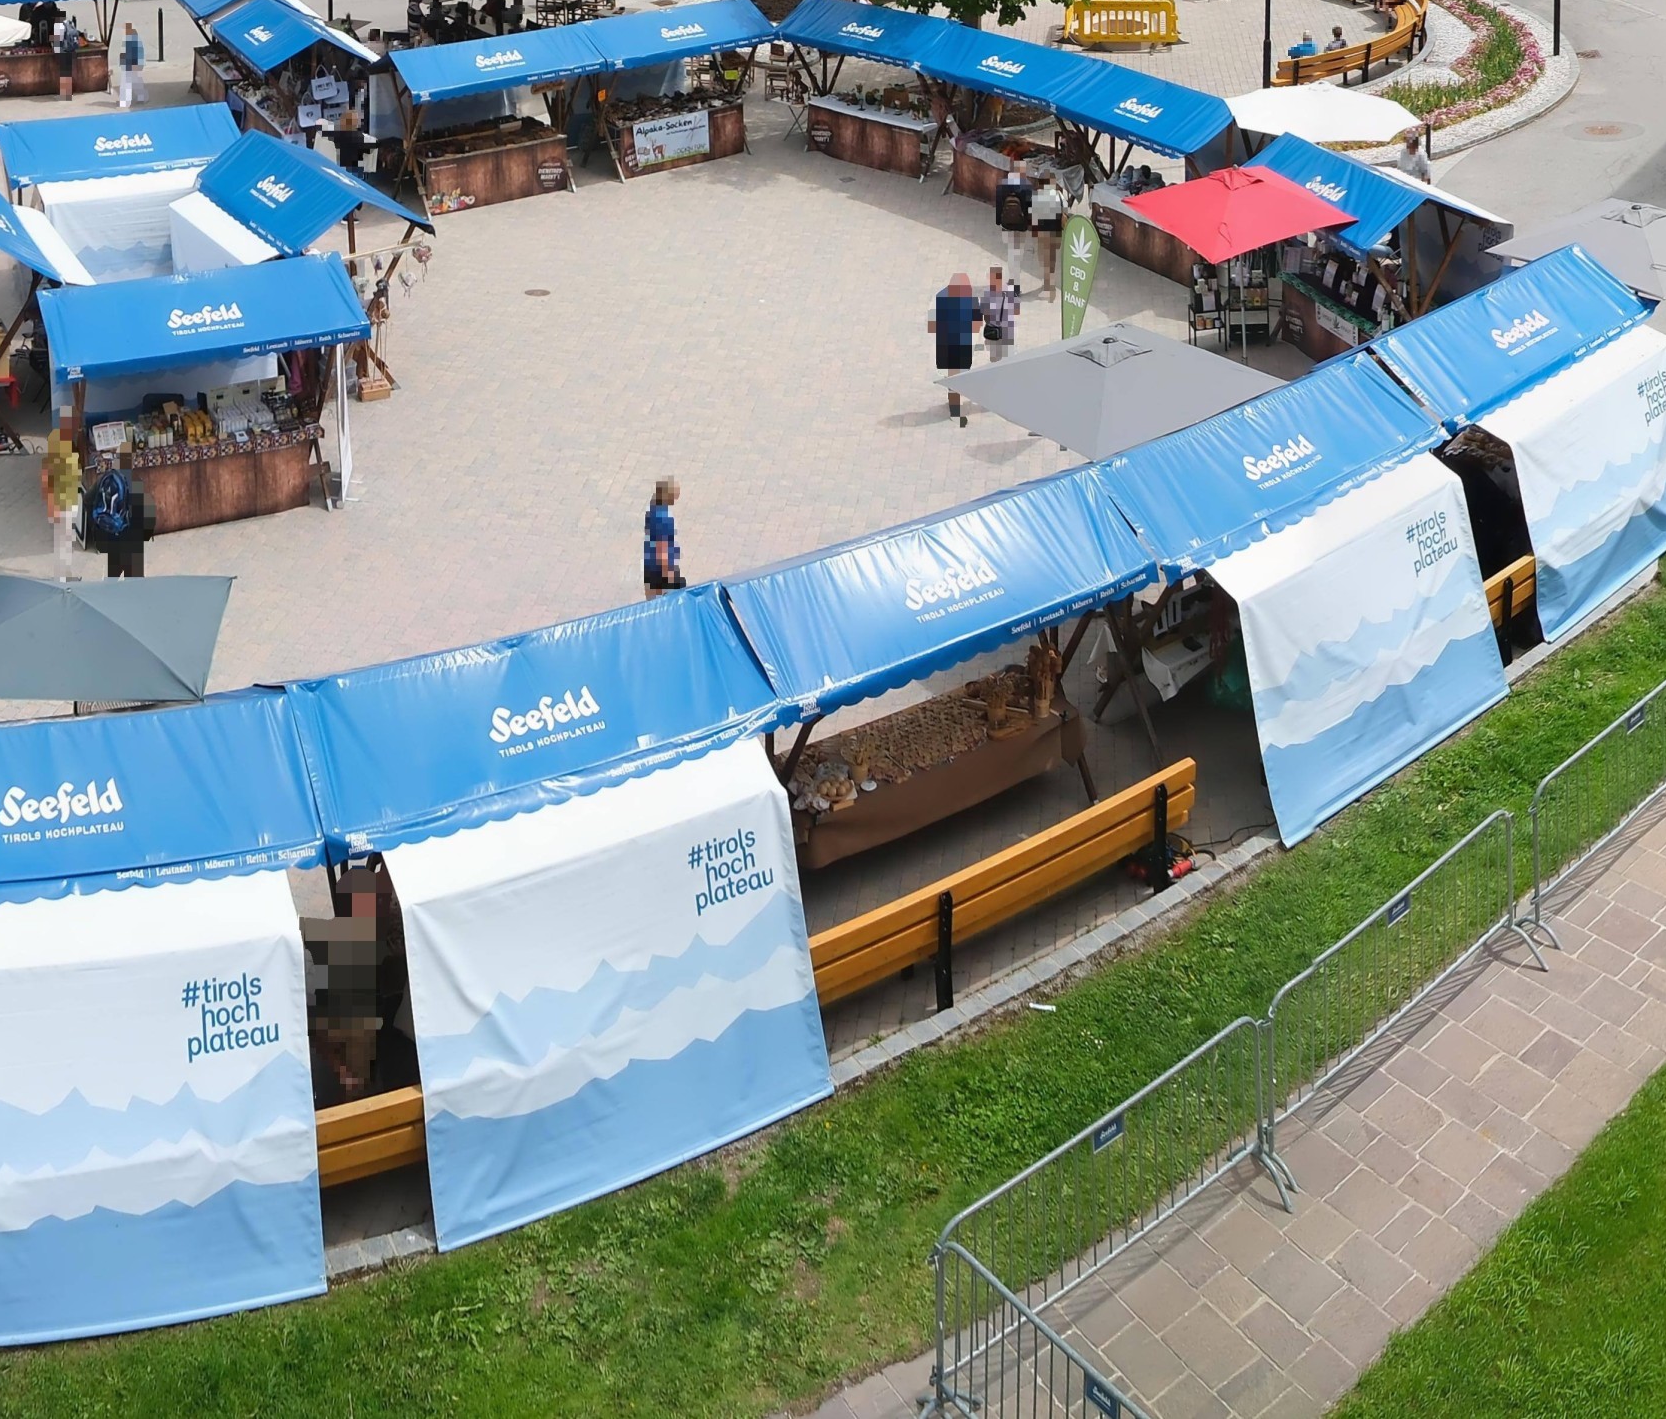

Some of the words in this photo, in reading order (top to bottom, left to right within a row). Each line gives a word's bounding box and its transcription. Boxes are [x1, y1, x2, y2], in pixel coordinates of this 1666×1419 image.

[661, 22, 706, 39] Seefeld
[841, 21, 885, 39] Seefeld
[475, 49, 523, 69] Seefeld
[981, 54, 1026, 75] Seefeld
[1119, 97, 1164, 119] Seefeld
[94, 133, 153, 152] Seefeld
[636, 119, 693, 137] Alpaka-Socken
[257, 174, 295, 203] Seefeld
[1305, 174, 1348, 203] Seefeld
[1069, 264, 1086, 281] CBD
[1073, 281, 1080, 292] &
[167, 301, 243, 329] Seefeld
[1491, 308, 1551, 350] Seefeld
[1242, 433, 1316, 481] Seefeld
[1257, 475, 1282, 491] TIROLS
[1405, 511, 1447, 543] #tirols
[1417, 527, 1447, 553] hoch
[1413, 537, 1458, 578] plateau
[905, 555, 999, 611] Seefeld
[915, 609, 947, 625] TIROLS
[947, 587, 1006, 615] HOCHPLATEAU
[488, 685, 601, 744] Seefeld
[498, 741, 535, 759] TIROLS
[536, 719, 606, 748] HOCHPLATEAU
[2, 829, 42, 844] TIROLS
[45, 821, 126, 841] HOCHPLATEAU
[687, 828, 756, 871] #tirols
[706, 852, 756, 887] hoch
[695, 865, 775, 916] plateau
[181, 974, 263, 1009] #tirols
[201, 995, 261, 1028] hoch
[186, 1022, 280, 1063] plateau
